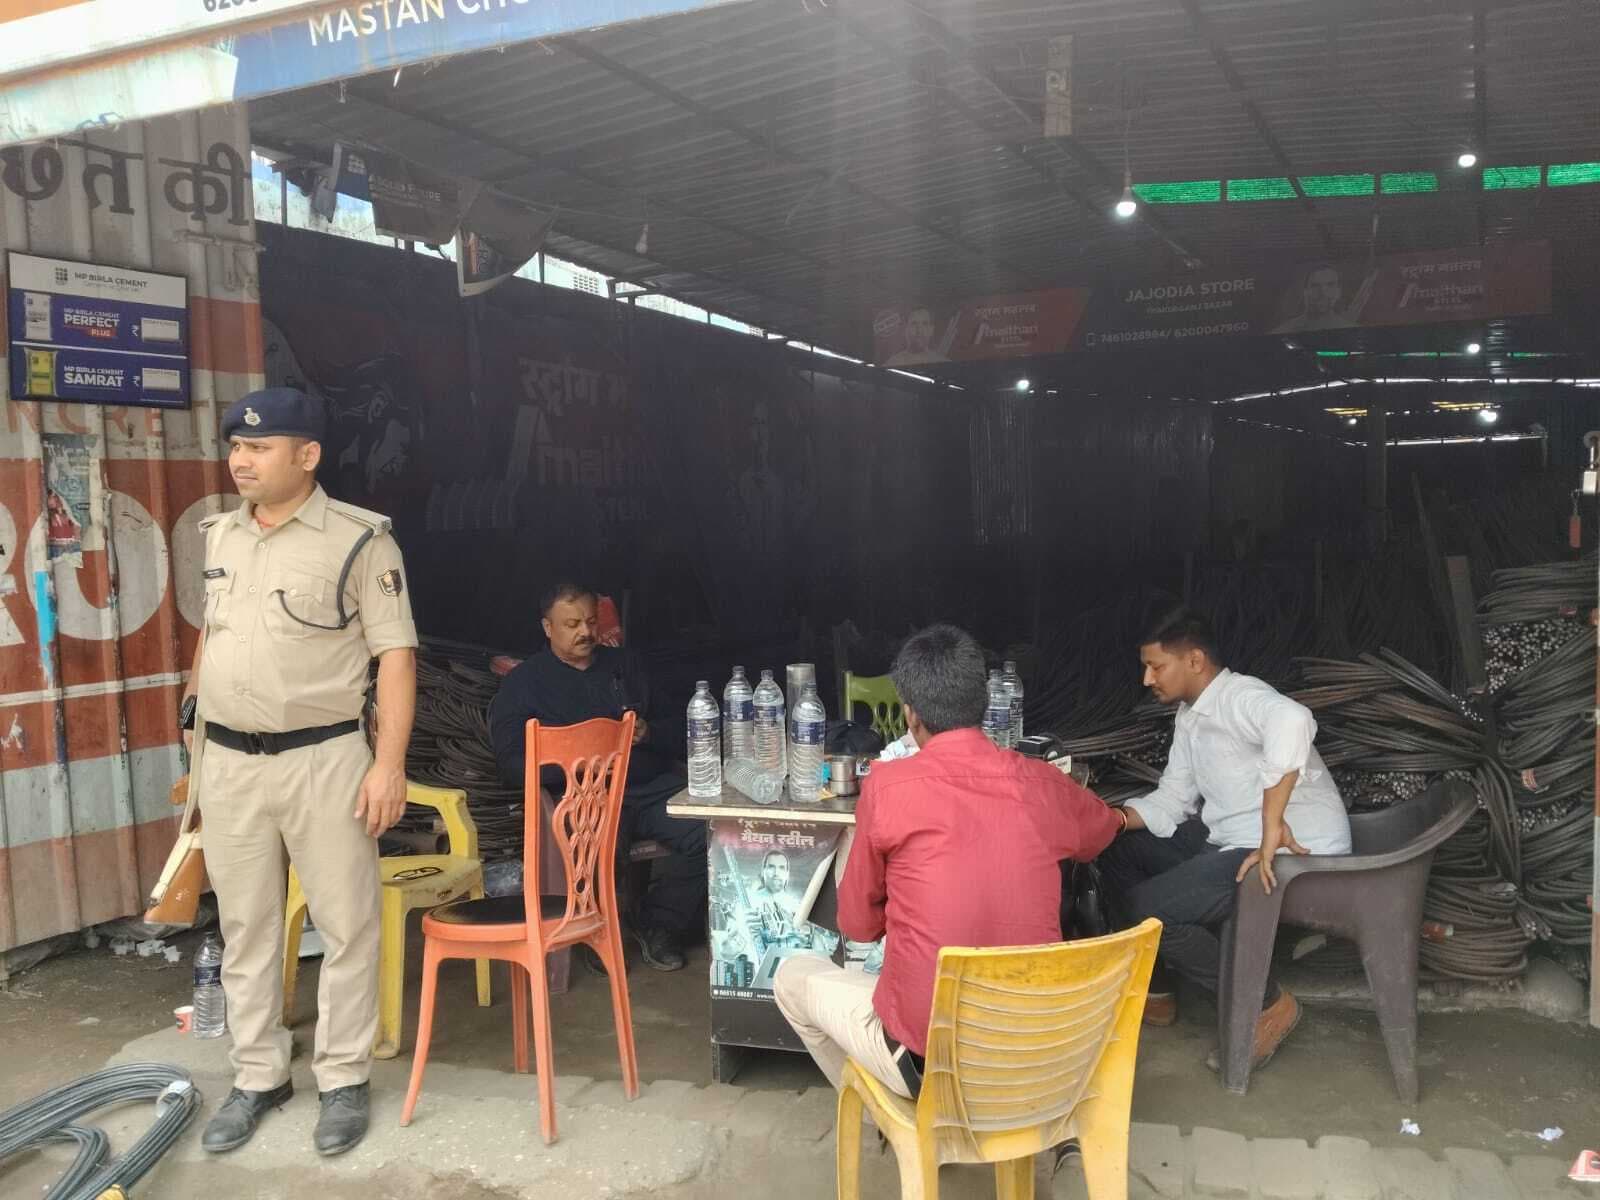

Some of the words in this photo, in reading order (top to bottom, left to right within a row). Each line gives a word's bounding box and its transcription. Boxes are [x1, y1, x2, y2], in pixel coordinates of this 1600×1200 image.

[308, 0, 445, 46] MASTAN
[158, 142, 251, 226] की
[89, 273, 113, 283] BIRLA
[115, 277, 148, 288] CEMENT
[1124, 284, 1196, 303] JAJODIA
[1199, 278, 1256, 295] STORE
[63, 313, 120, 328] PERFECT
[63, 373, 125, 387] SAMRAT
